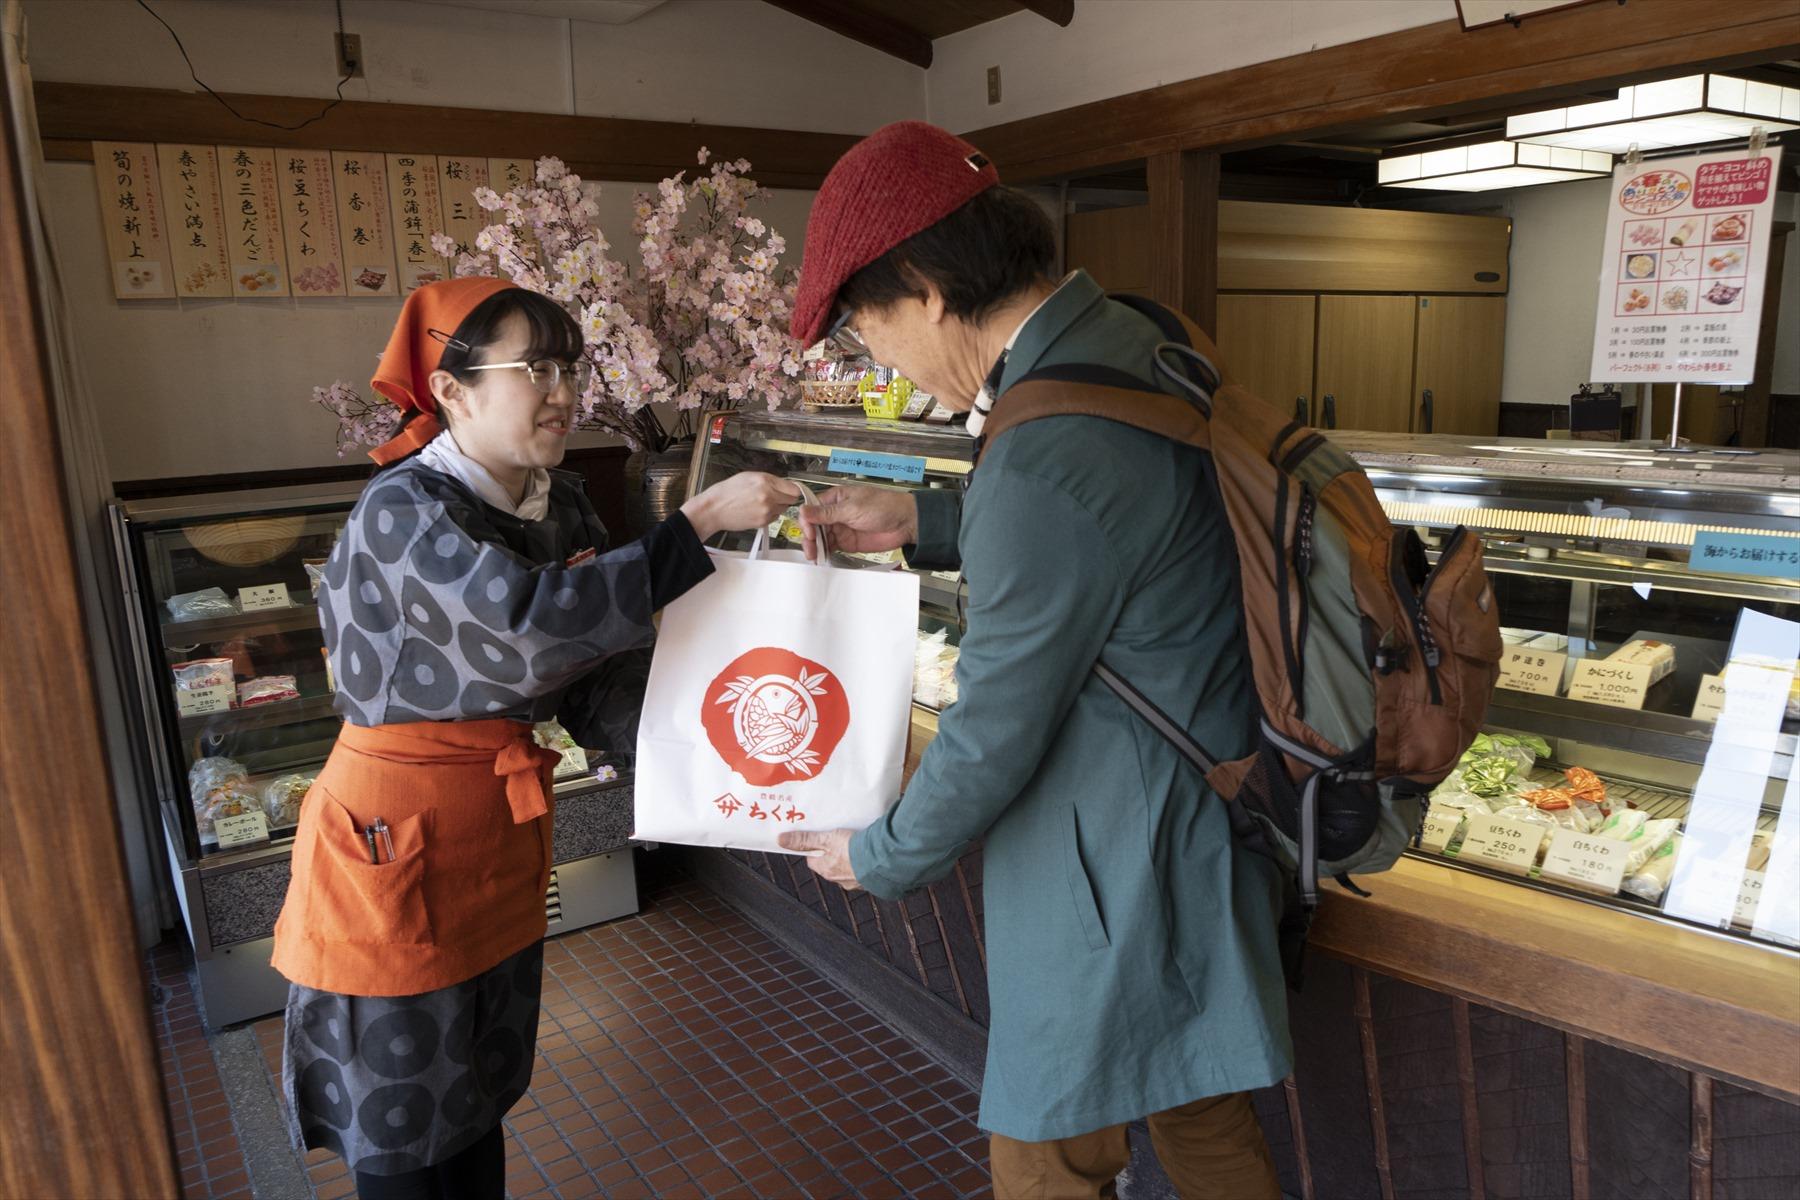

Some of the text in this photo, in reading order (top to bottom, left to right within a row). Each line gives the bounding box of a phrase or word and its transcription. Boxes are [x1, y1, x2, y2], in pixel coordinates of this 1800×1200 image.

[178, 150, 207, 248] 春やさい満点
[233, 150, 262, 261] 春の三色だんご
[288, 158, 316, 256] 桜豆ちくわ
[1519, 671, 1549, 682] 700円
[1588, 667, 1634, 681] かにづくし
[749, 801, 805, 823] ちくわ
[1493, 840, 1527, 854] 250円
[1573, 840, 1610, 855] 白ちくわ
